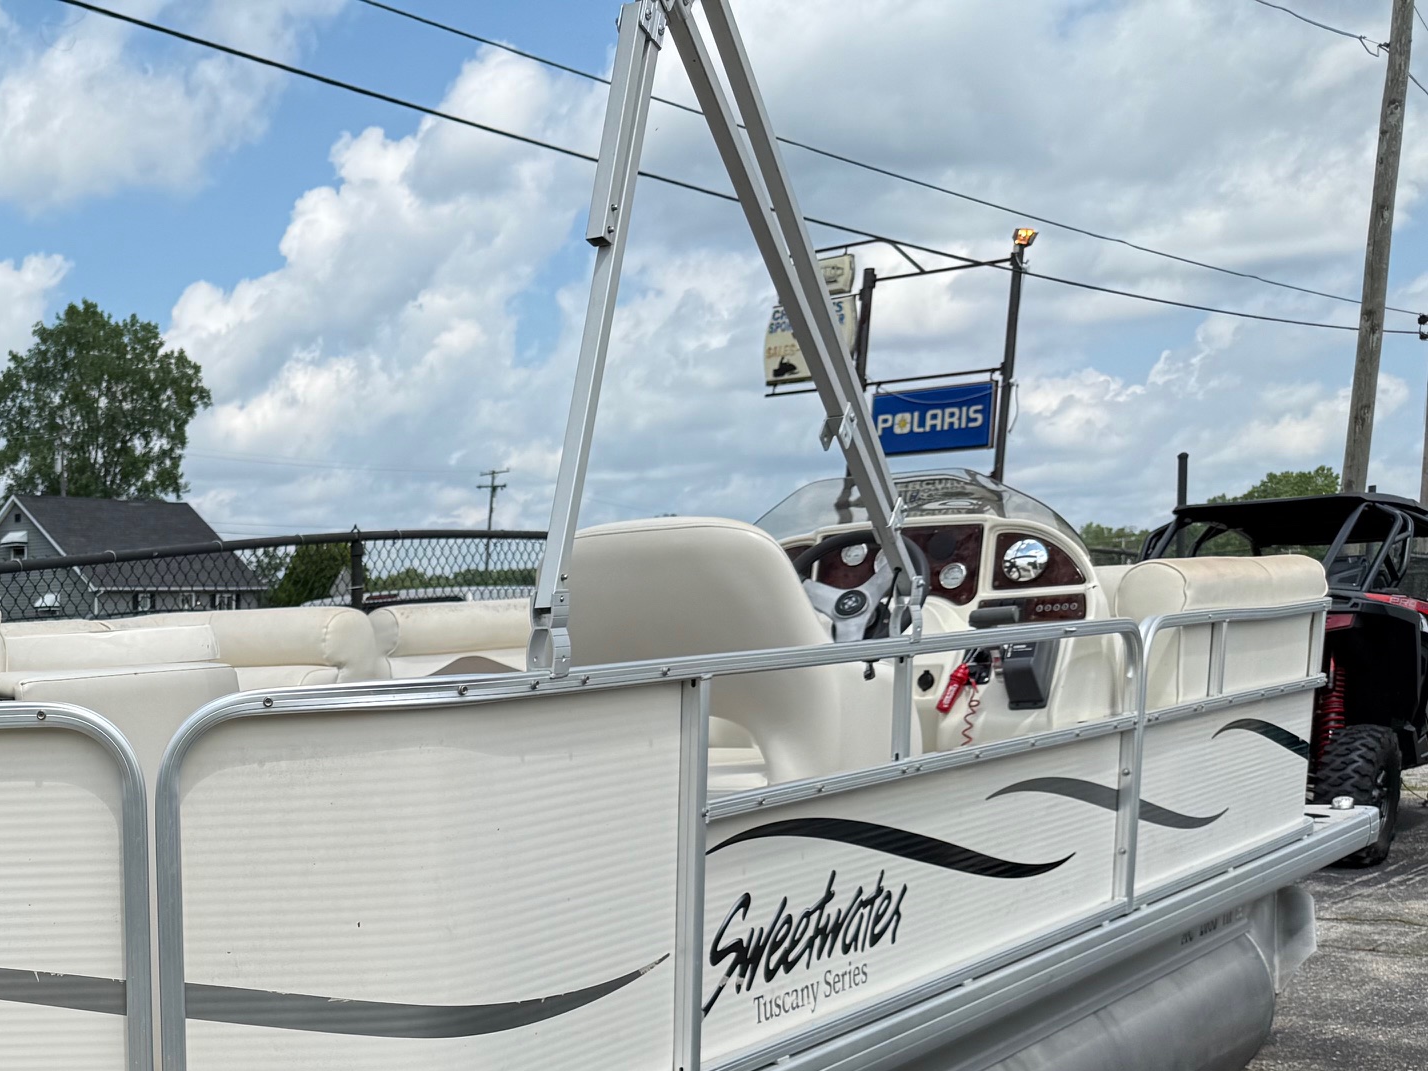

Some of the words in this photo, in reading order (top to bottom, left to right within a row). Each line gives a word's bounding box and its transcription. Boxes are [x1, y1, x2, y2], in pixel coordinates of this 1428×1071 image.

[876, 405, 983, 437] POLARIS
[701, 869, 908, 1018] Sweetwater
[753, 978, 820, 1025] Tuscany
[823, 960, 869, 998] Series
